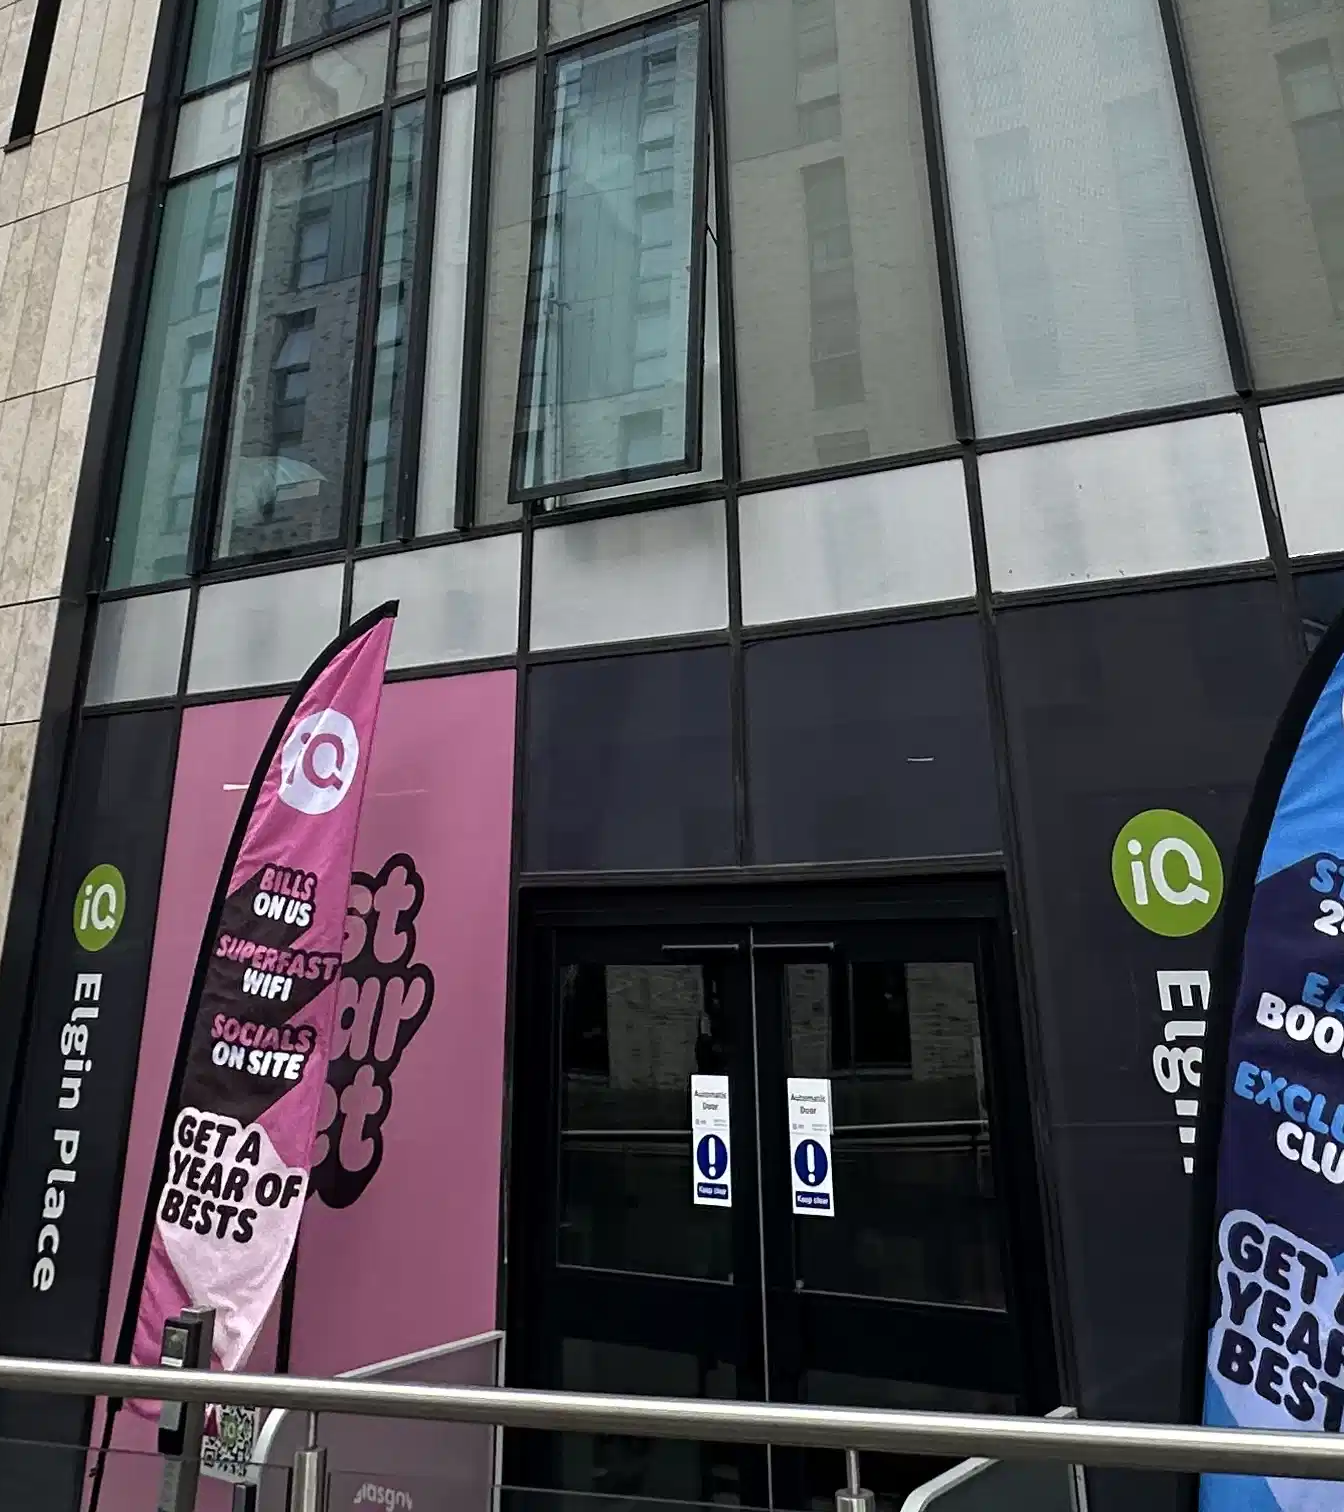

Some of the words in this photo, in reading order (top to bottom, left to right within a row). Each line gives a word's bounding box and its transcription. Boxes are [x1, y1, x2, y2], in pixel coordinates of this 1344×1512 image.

[260, 867, 316, 901] BILLS
[1126, 838, 1210, 905] iQ
[80, 883, 116, 931] iQ
[254, 892, 286, 920] ON
[283, 900, 312, 927] US
[344, 865, 416, 963] st
[216, 934, 340, 980] SUPERFAST
[242, 967, 293, 1002] WIFI
[58, 973, 103, 1109] Elgin
[211, 1013, 312, 1053] SOCIALS
[333, 976, 426, 1062] ar
[212, 1041, 245, 1070] ON
[247, 1050, 304, 1080] SITE
[1154, 970, 1210, 1174] Elg
[800, 1105, 817, 1115] Door
[178, 1115, 236, 1158] GET
[235, 1131, 261, 1166] A
[172, 1150, 249, 1202] YEAR
[256, 1173, 302, 1209] OF
[32, 1129, 81, 1291] Place
[161, 1188, 257, 1244] BESTS
[1227, 1221, 1329, 1305] GET
